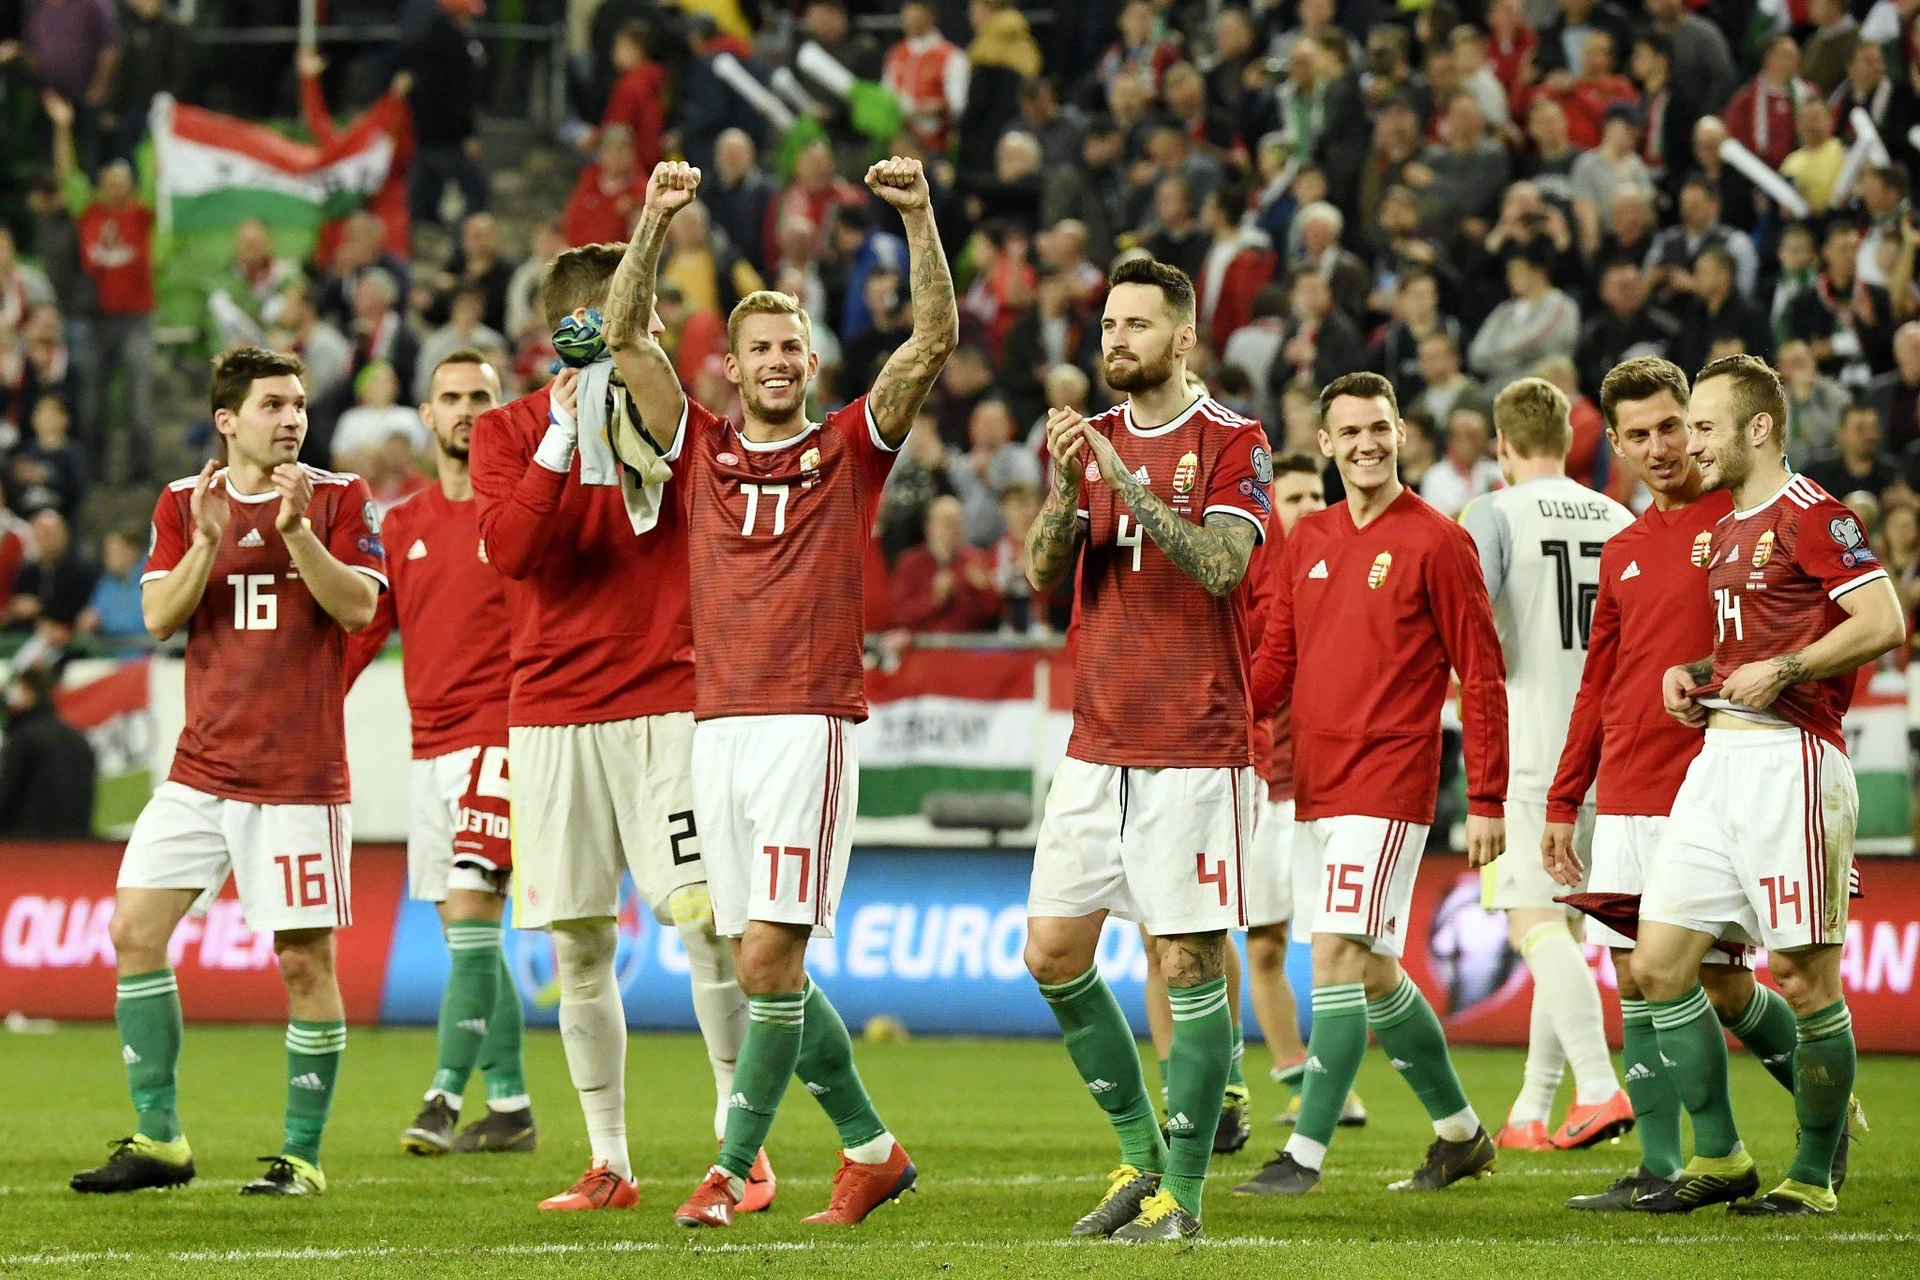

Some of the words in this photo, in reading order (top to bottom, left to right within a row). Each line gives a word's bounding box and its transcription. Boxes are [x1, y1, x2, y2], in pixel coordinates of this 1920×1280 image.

[740, 483, 790, 536] 17
[1116, 514, 1143, 572] 4
[227, 573, 277, 630] 16
[1714, 588, 1743, 643] 14
[275, 853, 328, 907] 16
[763, 845, 811, 903] 17
[1196, 853, 1228, 906] 4
[1325, 863, 1364, 913] 15
[1759, 875, 1802, 929] 14
[846, 904, 1030, 980] EURO
